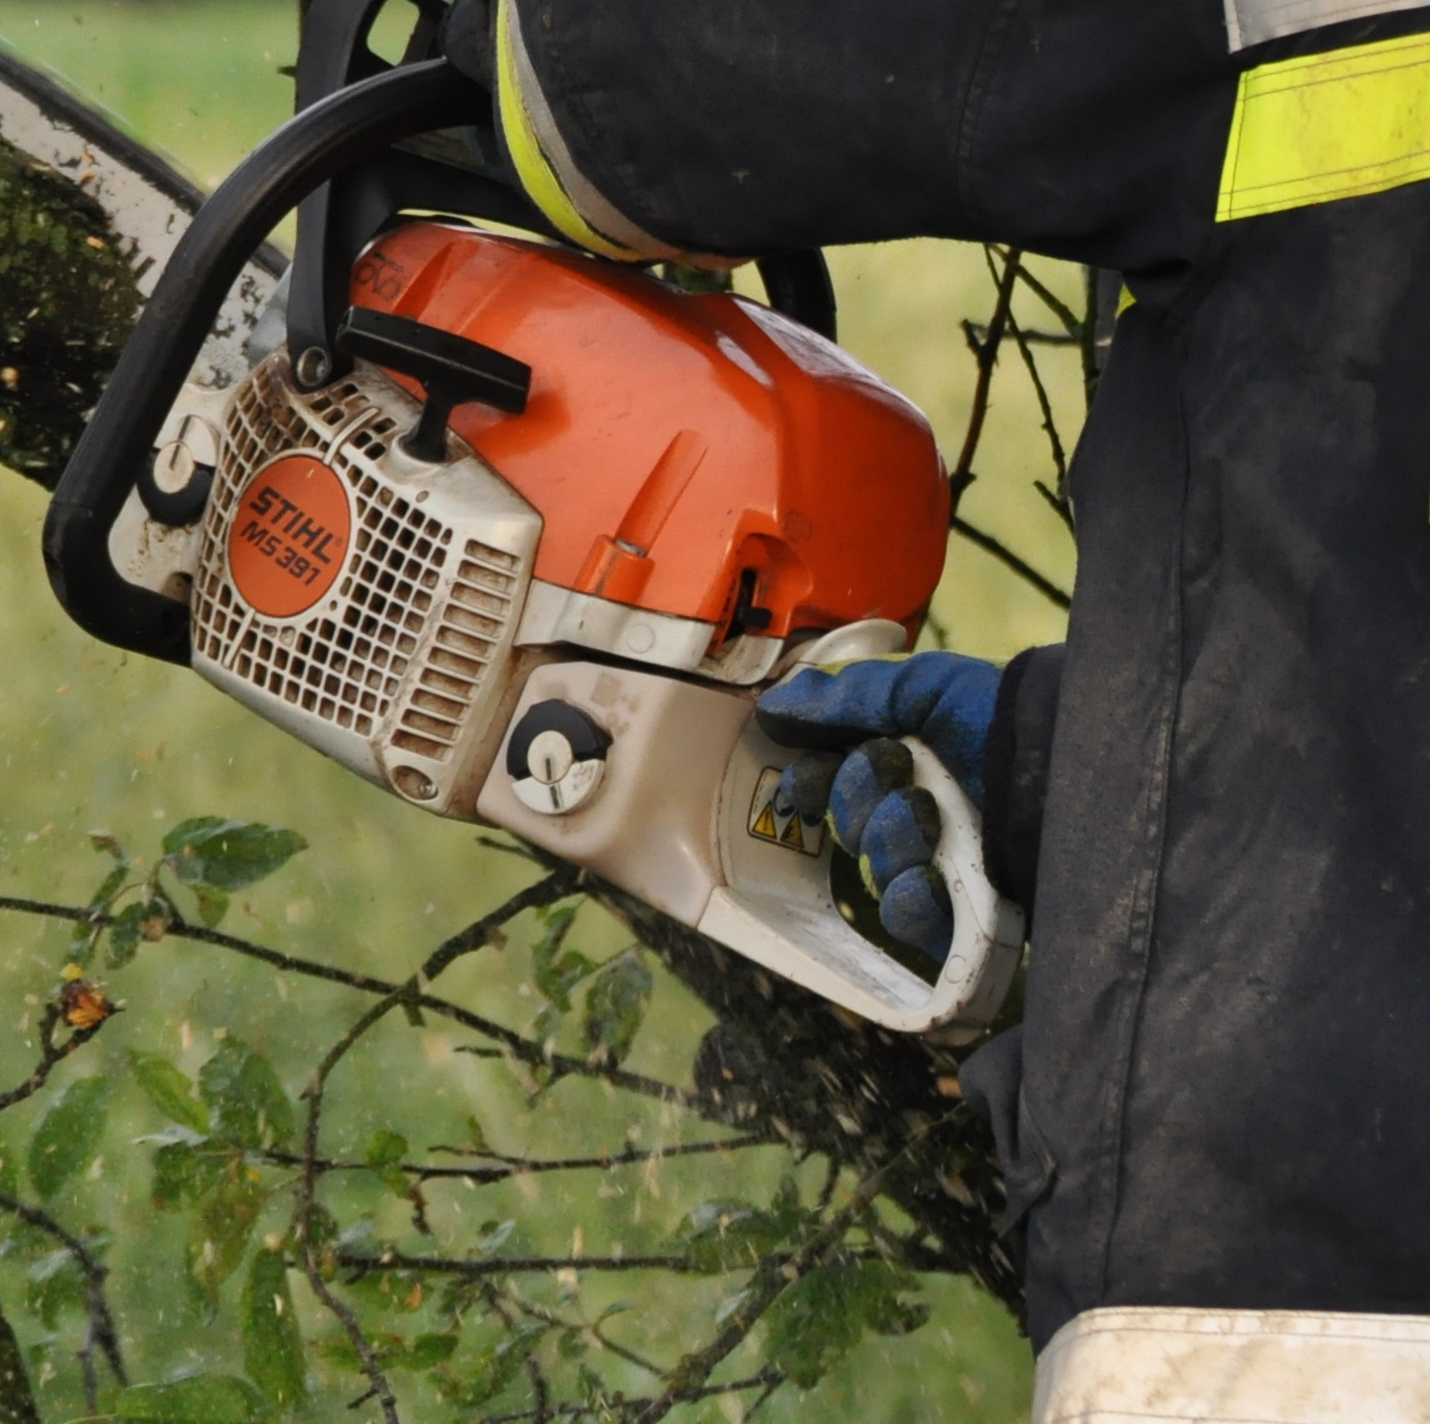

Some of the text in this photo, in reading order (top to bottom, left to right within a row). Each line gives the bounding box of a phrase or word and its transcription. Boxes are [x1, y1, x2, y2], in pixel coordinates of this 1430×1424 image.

[240, 520, 321, 586] MS 391
[249, 486, 334, 565] STIHL
